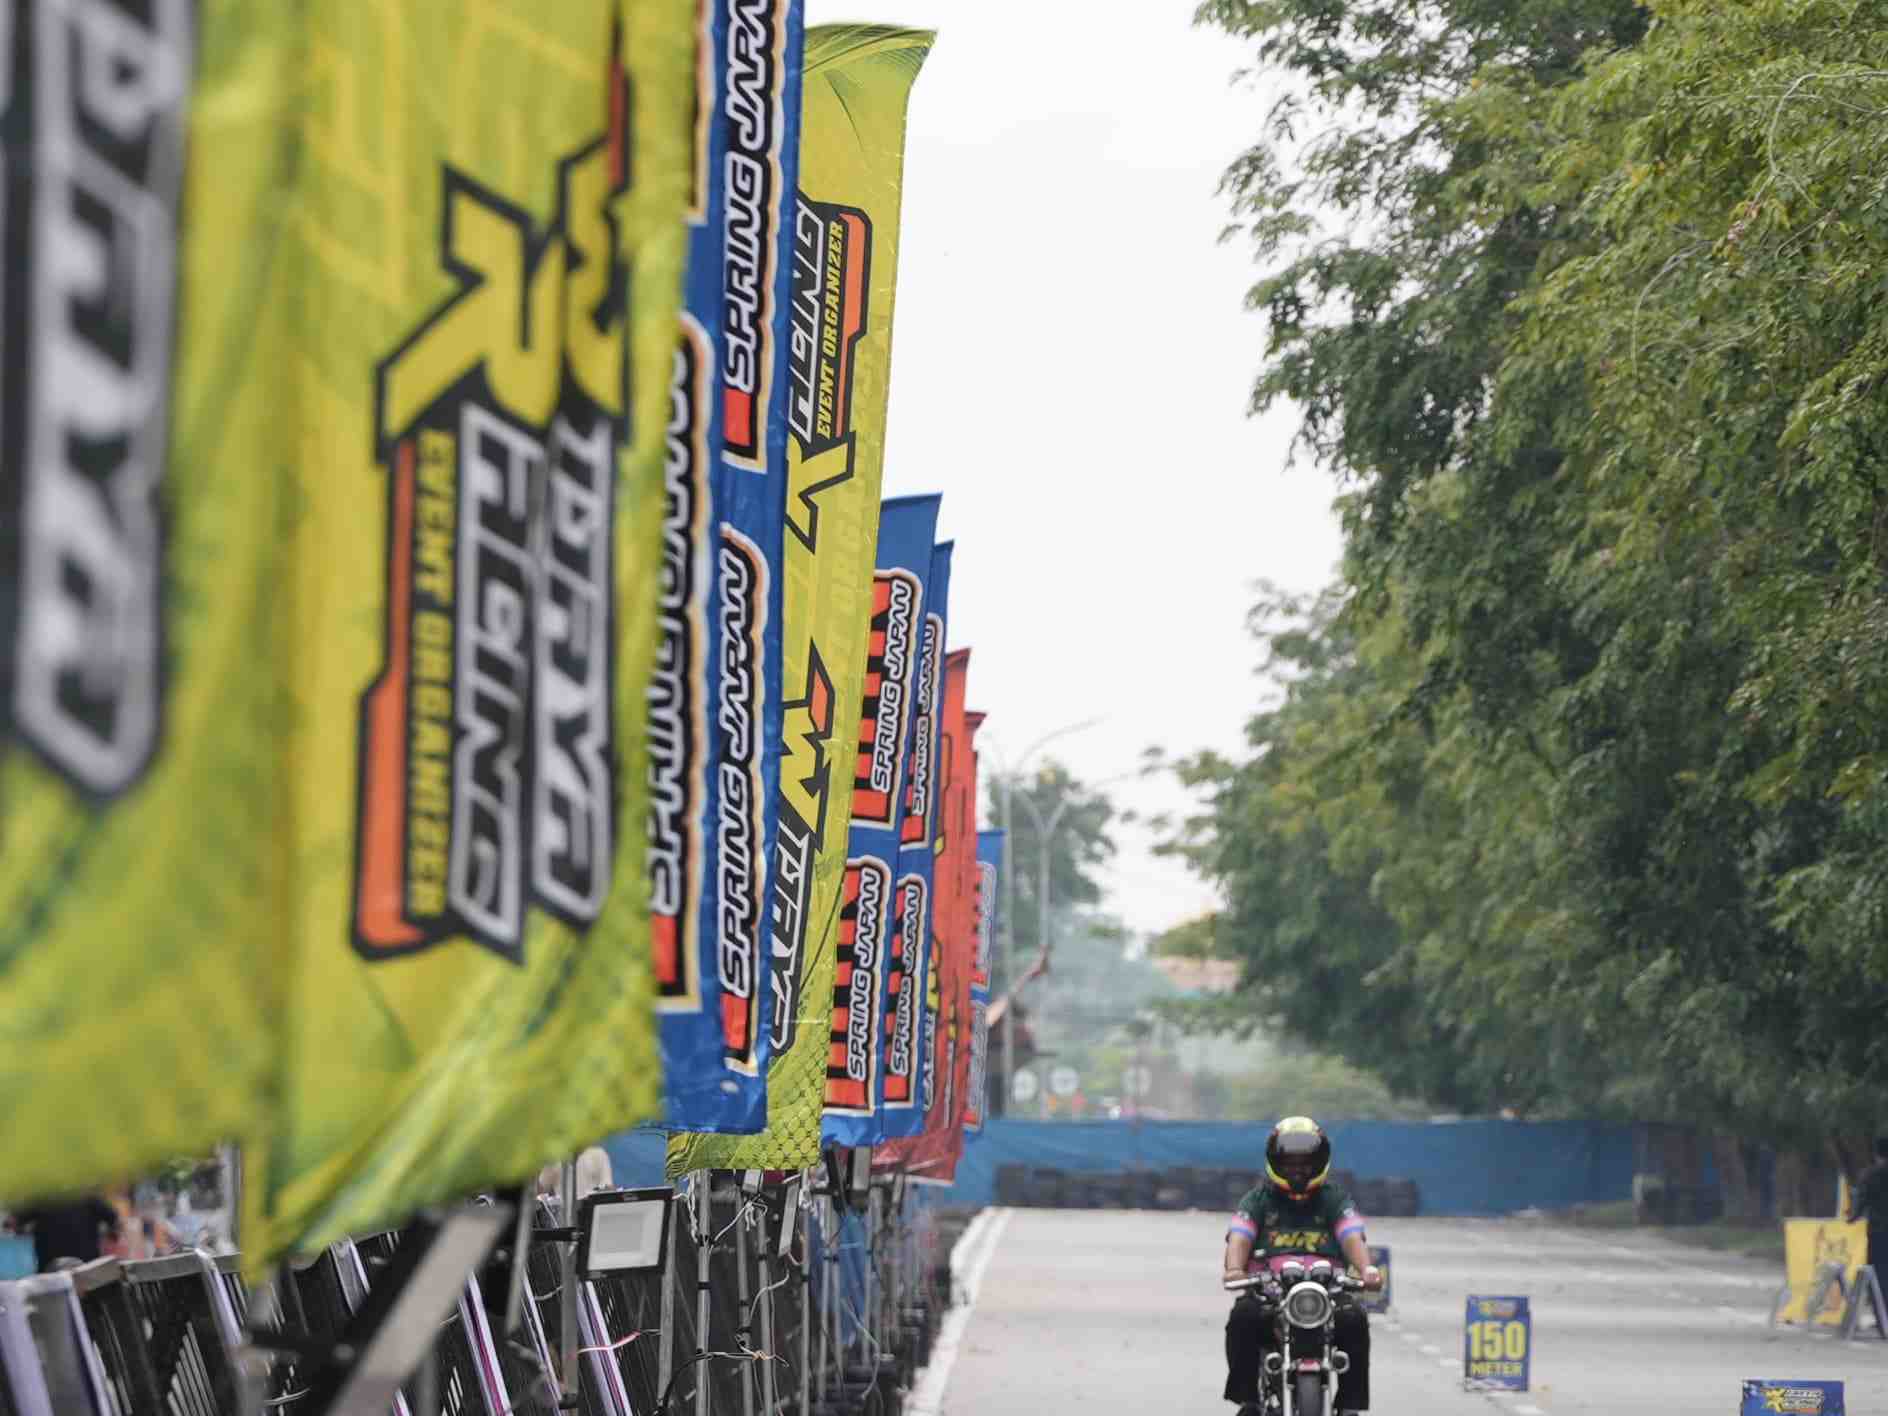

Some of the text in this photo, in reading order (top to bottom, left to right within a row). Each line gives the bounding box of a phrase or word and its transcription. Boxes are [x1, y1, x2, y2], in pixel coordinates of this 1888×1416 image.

[723, 0, 767, 393] SPRING JAPA
[817, 220, 846, 439] EVENT ORGANIZER
[405, 429, 455, 918] EVENT ORGANIZER
[717, 547, 750, 998] SPRING JAPAN
[870, 578, 912, 793] SPRING JAPAN
[917, 624, 936, 714] JAPAN
[848, 866, 882, 1081] SPRING JAPAN
[889, 883, 921, 1077] SPRING JAPAN
[1468, 1321, 1526, 1361] 150
